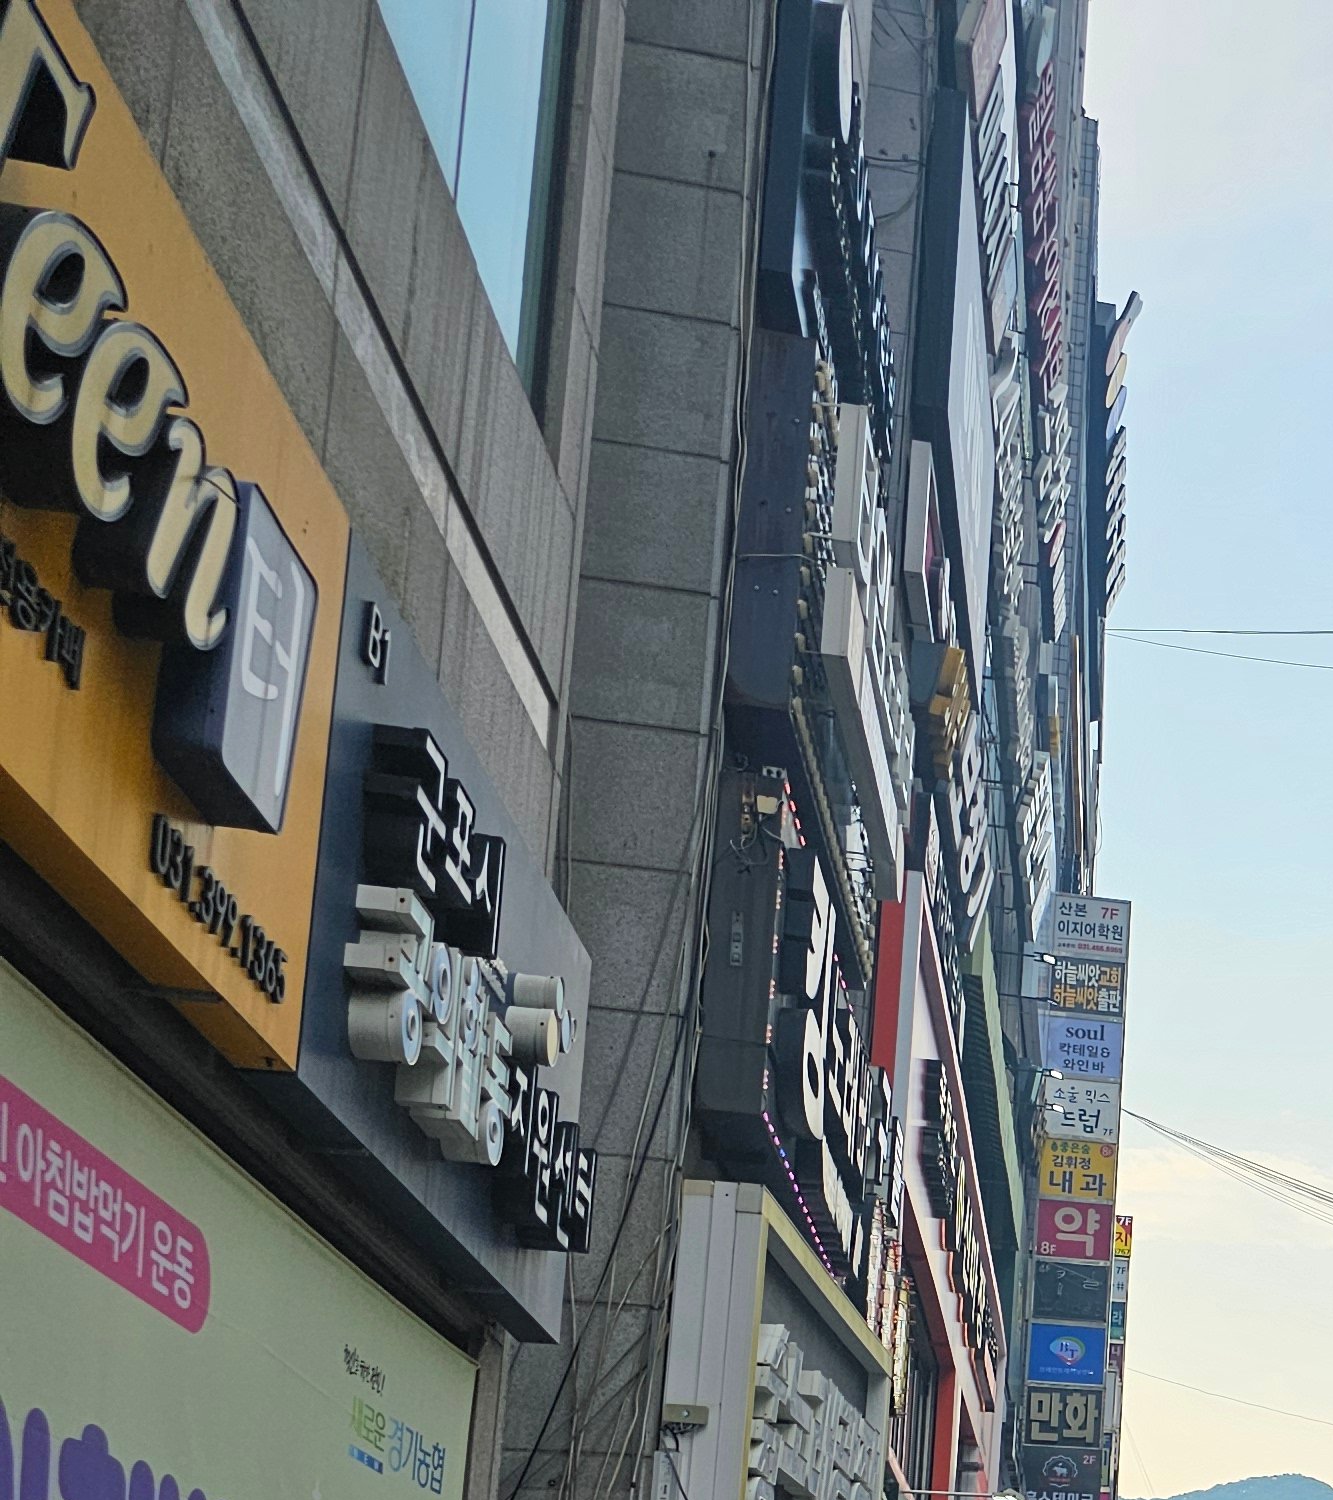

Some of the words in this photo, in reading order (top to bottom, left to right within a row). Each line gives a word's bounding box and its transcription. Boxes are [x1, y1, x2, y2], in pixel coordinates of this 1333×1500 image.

[150, 812, 291, 1005] 031.399.1365
[1058, 901, 1089, 918] 산본
[1100, 906, 1120, 921] 7F
[1057, 919, 1125, 942] 이지어학원
[1054, 960, 1122, 990] 하늘씨앗교회
[1064, 1024, 1106, 1042] soul
[1060, 1108, 1102, 1134] 드럼
[16, 1120, 146, 1279] 아침밥먹기
[148, 1223, 196, 1312] 운동
[1053, 1205, 1102, 1258] 약
[1040, 1241, 1058, 1256] 8F
[1029, 1391, 1099, 1444] 만화
[388, 1414, 447, 1496] 경기농협
